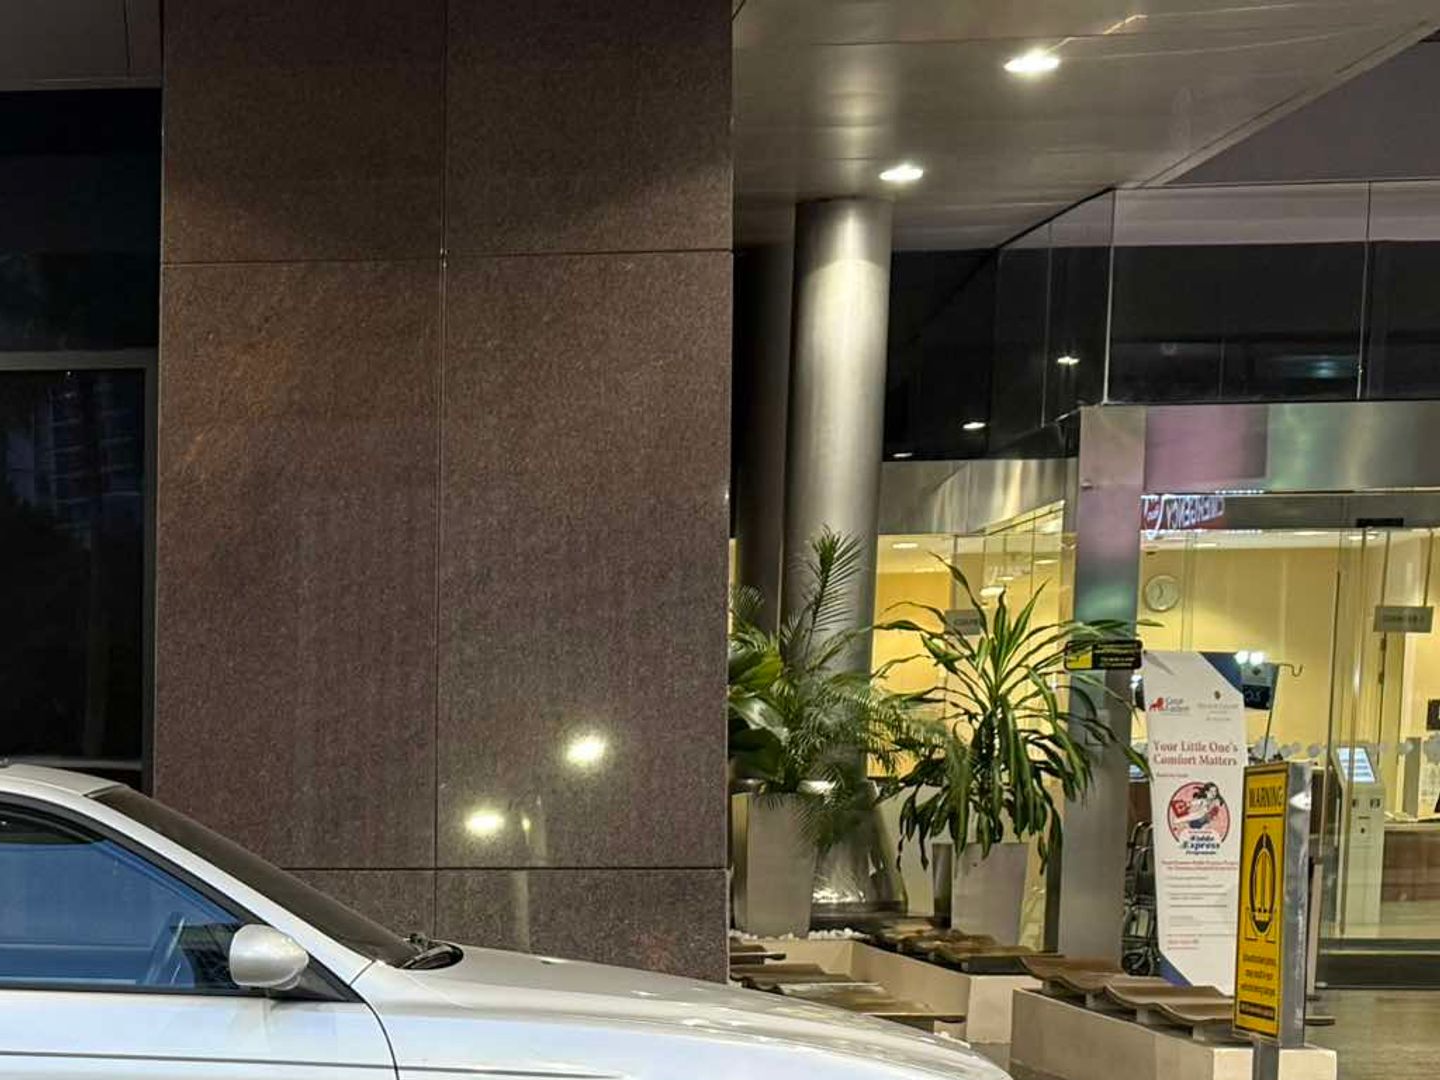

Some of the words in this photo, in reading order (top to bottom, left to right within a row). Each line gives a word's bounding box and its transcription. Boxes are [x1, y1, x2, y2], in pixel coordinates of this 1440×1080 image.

[1153, 741, 1178, 752] Your
[1181, 741, 1207, 752] Little
[1209, 741, 1239, 753] One's
[1153, 754, 1197, 765] Comfort
[1199, 755, 1238, 766] Matters
[1248, 785, 1283, 808] WARNING
